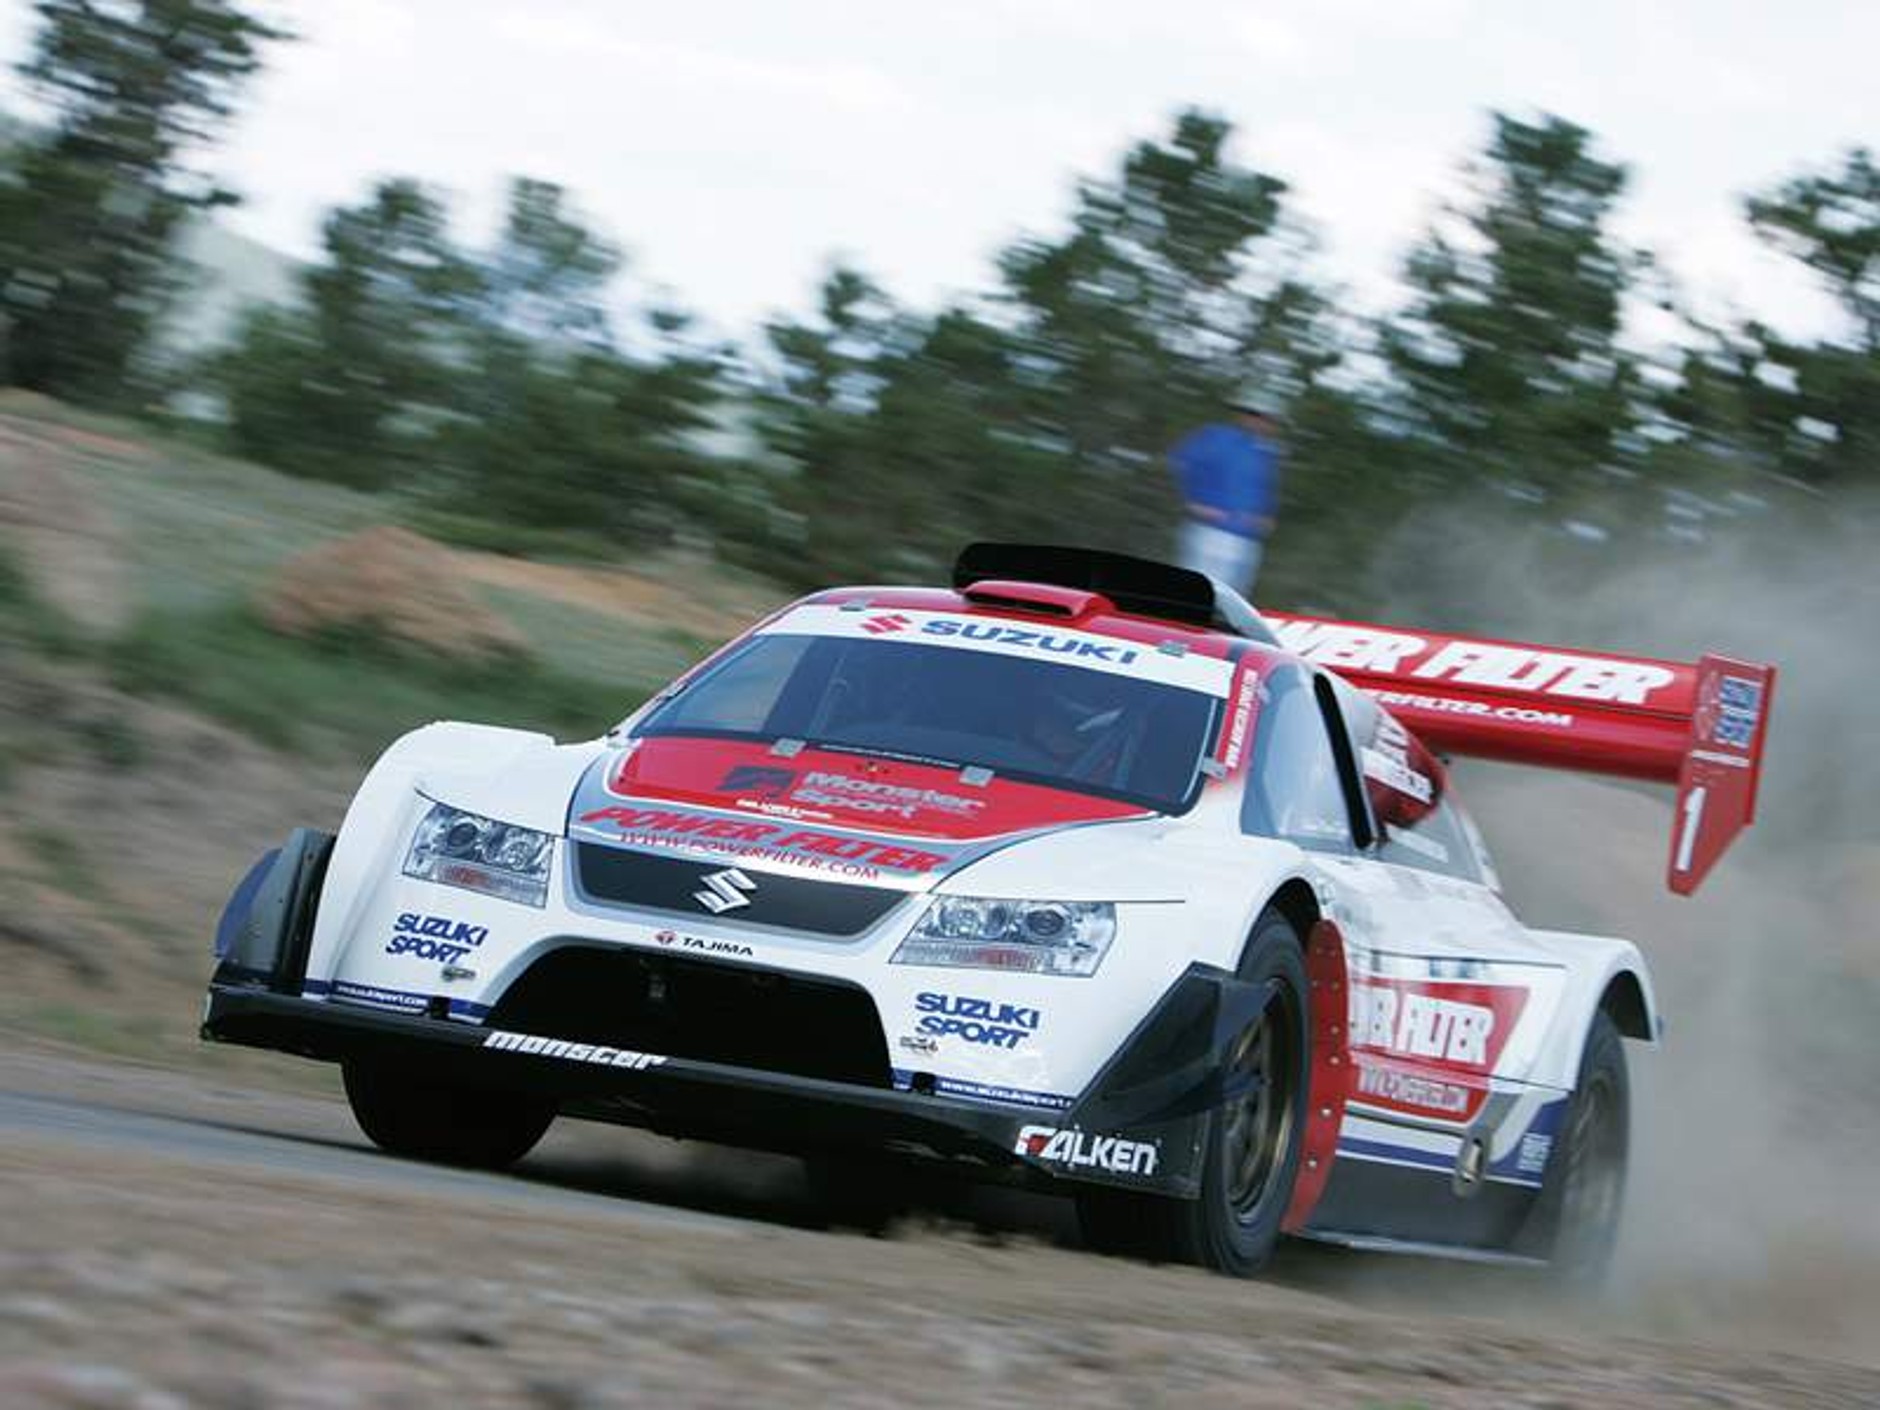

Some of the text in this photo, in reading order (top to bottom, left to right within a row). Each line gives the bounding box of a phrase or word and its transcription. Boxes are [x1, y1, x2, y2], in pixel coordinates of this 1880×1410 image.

[921, 620, 1139, 665] SUZUKI
[1409, 639, 1676, 704] FILTER
[580, 806, 781, 842] POWER
[777, 830, 952, 873] FILTER
[1675, 786, 1707, 871] 1
[386, 935, 471, 964] SPORT
[393, 913, 489, 946] SUZUKI
[683, 936, 754, 957] TAJIMA
[915, 992, 1041, 1030] SUZUKI
[915, 1017, 1030, 1051] SPORT
[1015, 1124, 1160, 1176] FALKEN
